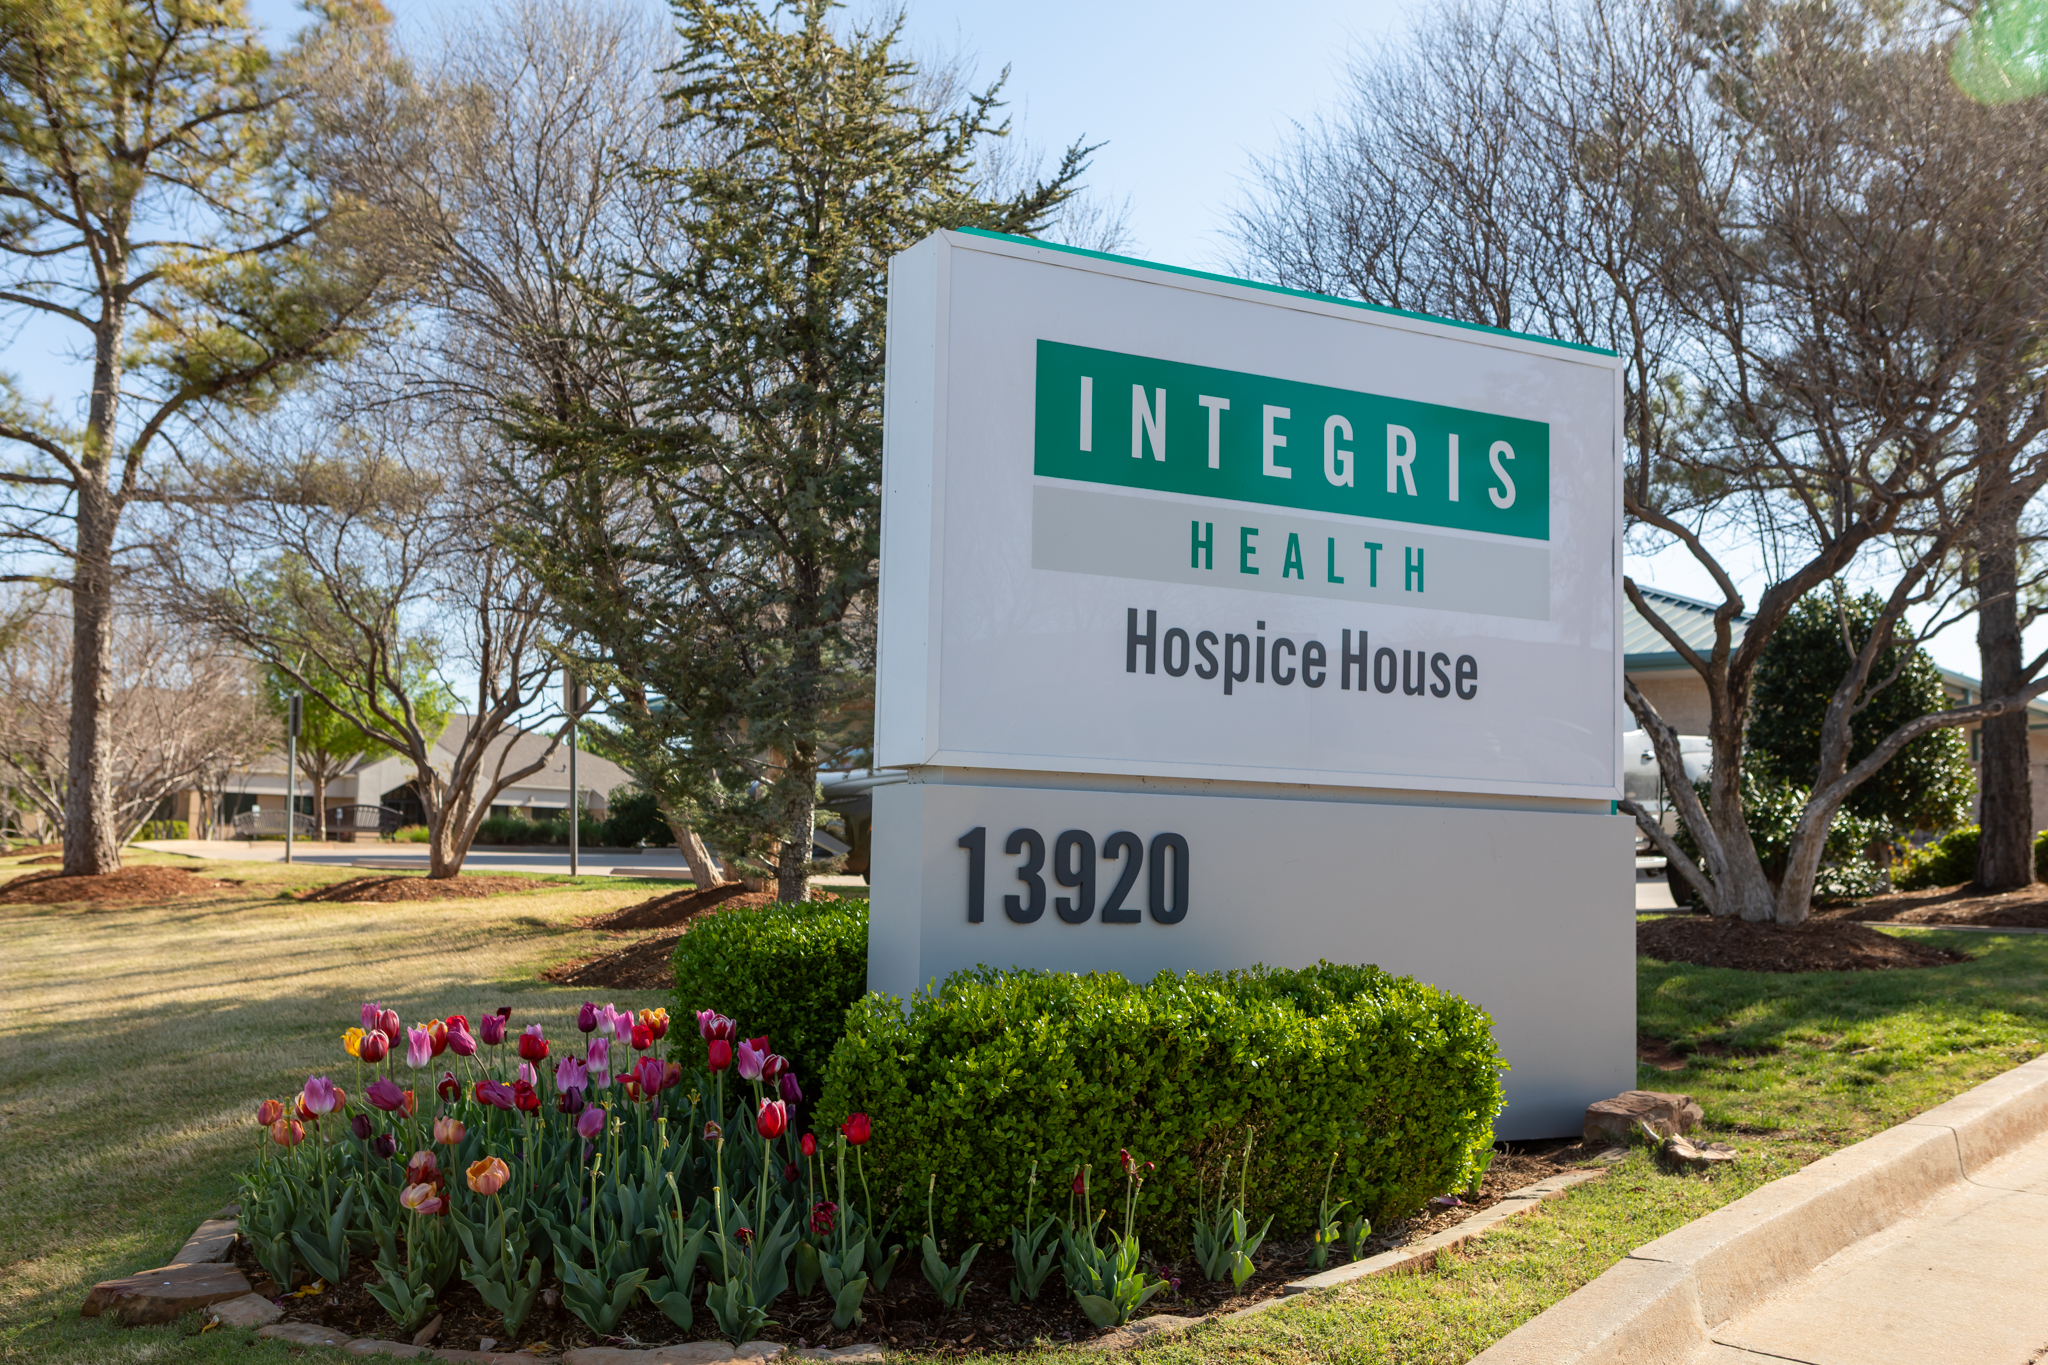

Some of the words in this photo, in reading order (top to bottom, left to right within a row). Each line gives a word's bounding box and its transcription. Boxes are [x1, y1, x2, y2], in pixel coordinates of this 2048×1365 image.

[1078, 375, 1517, 510] INTEGRIS
[1190, 520, 1425, 593] HEALTH
[1125, 607, 1327, 696] Hospice
[1340, 628, 1479, 701] House
[957, 826, 1190, 926] 13920
